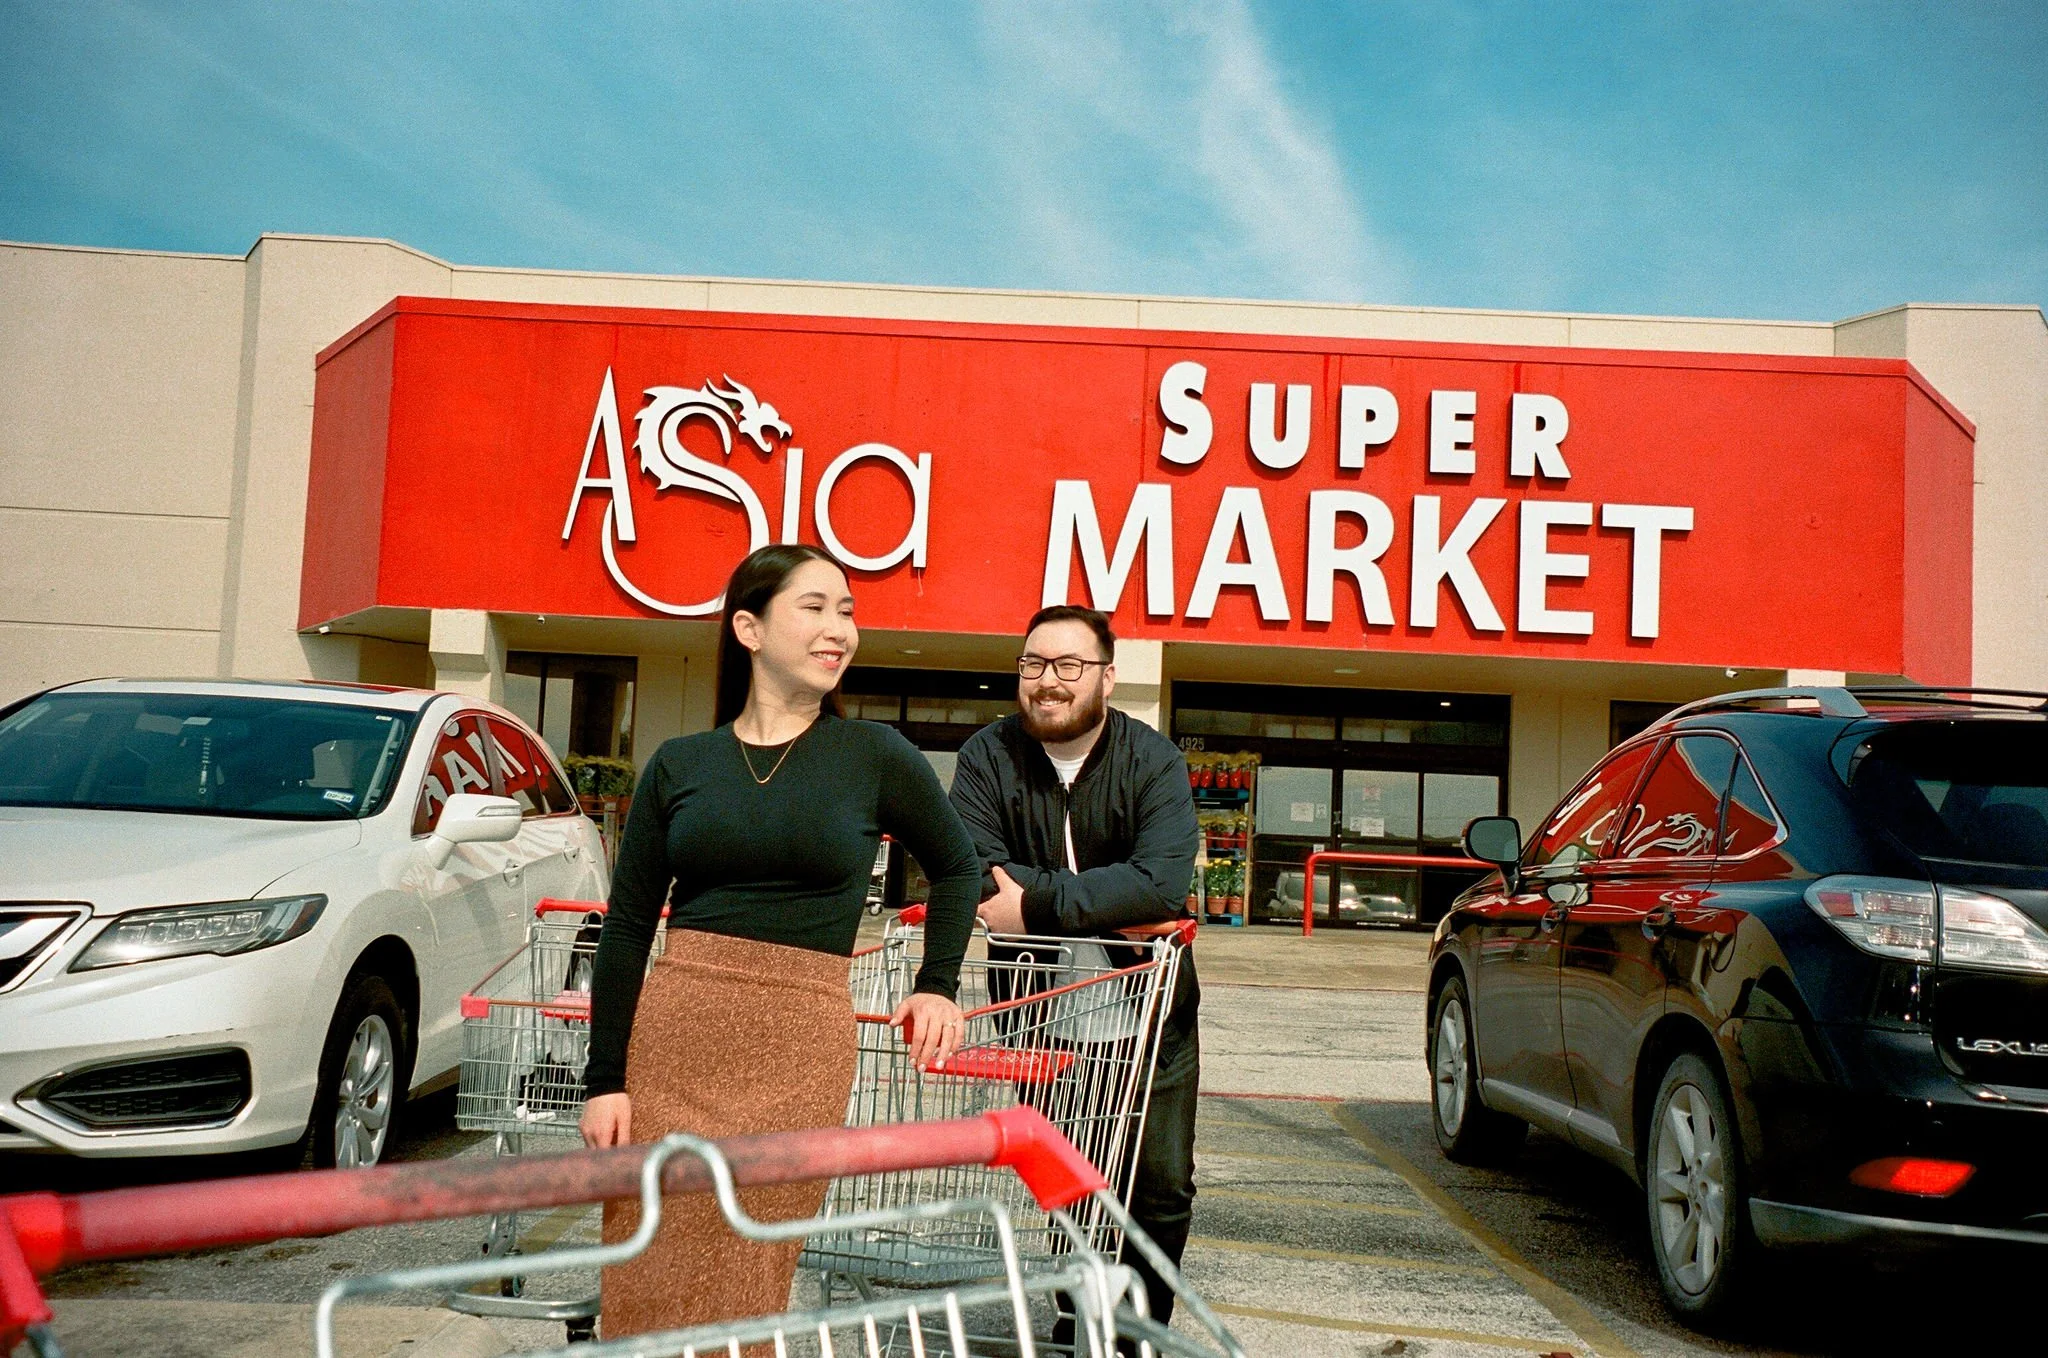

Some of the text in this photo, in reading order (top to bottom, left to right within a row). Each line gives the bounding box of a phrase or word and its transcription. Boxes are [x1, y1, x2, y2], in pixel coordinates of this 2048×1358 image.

[1159, 361, 1571, 479] SUPER
[1041, 480, 1694, 639] MARKET
[1179, 737, 1205, 750] 4925
